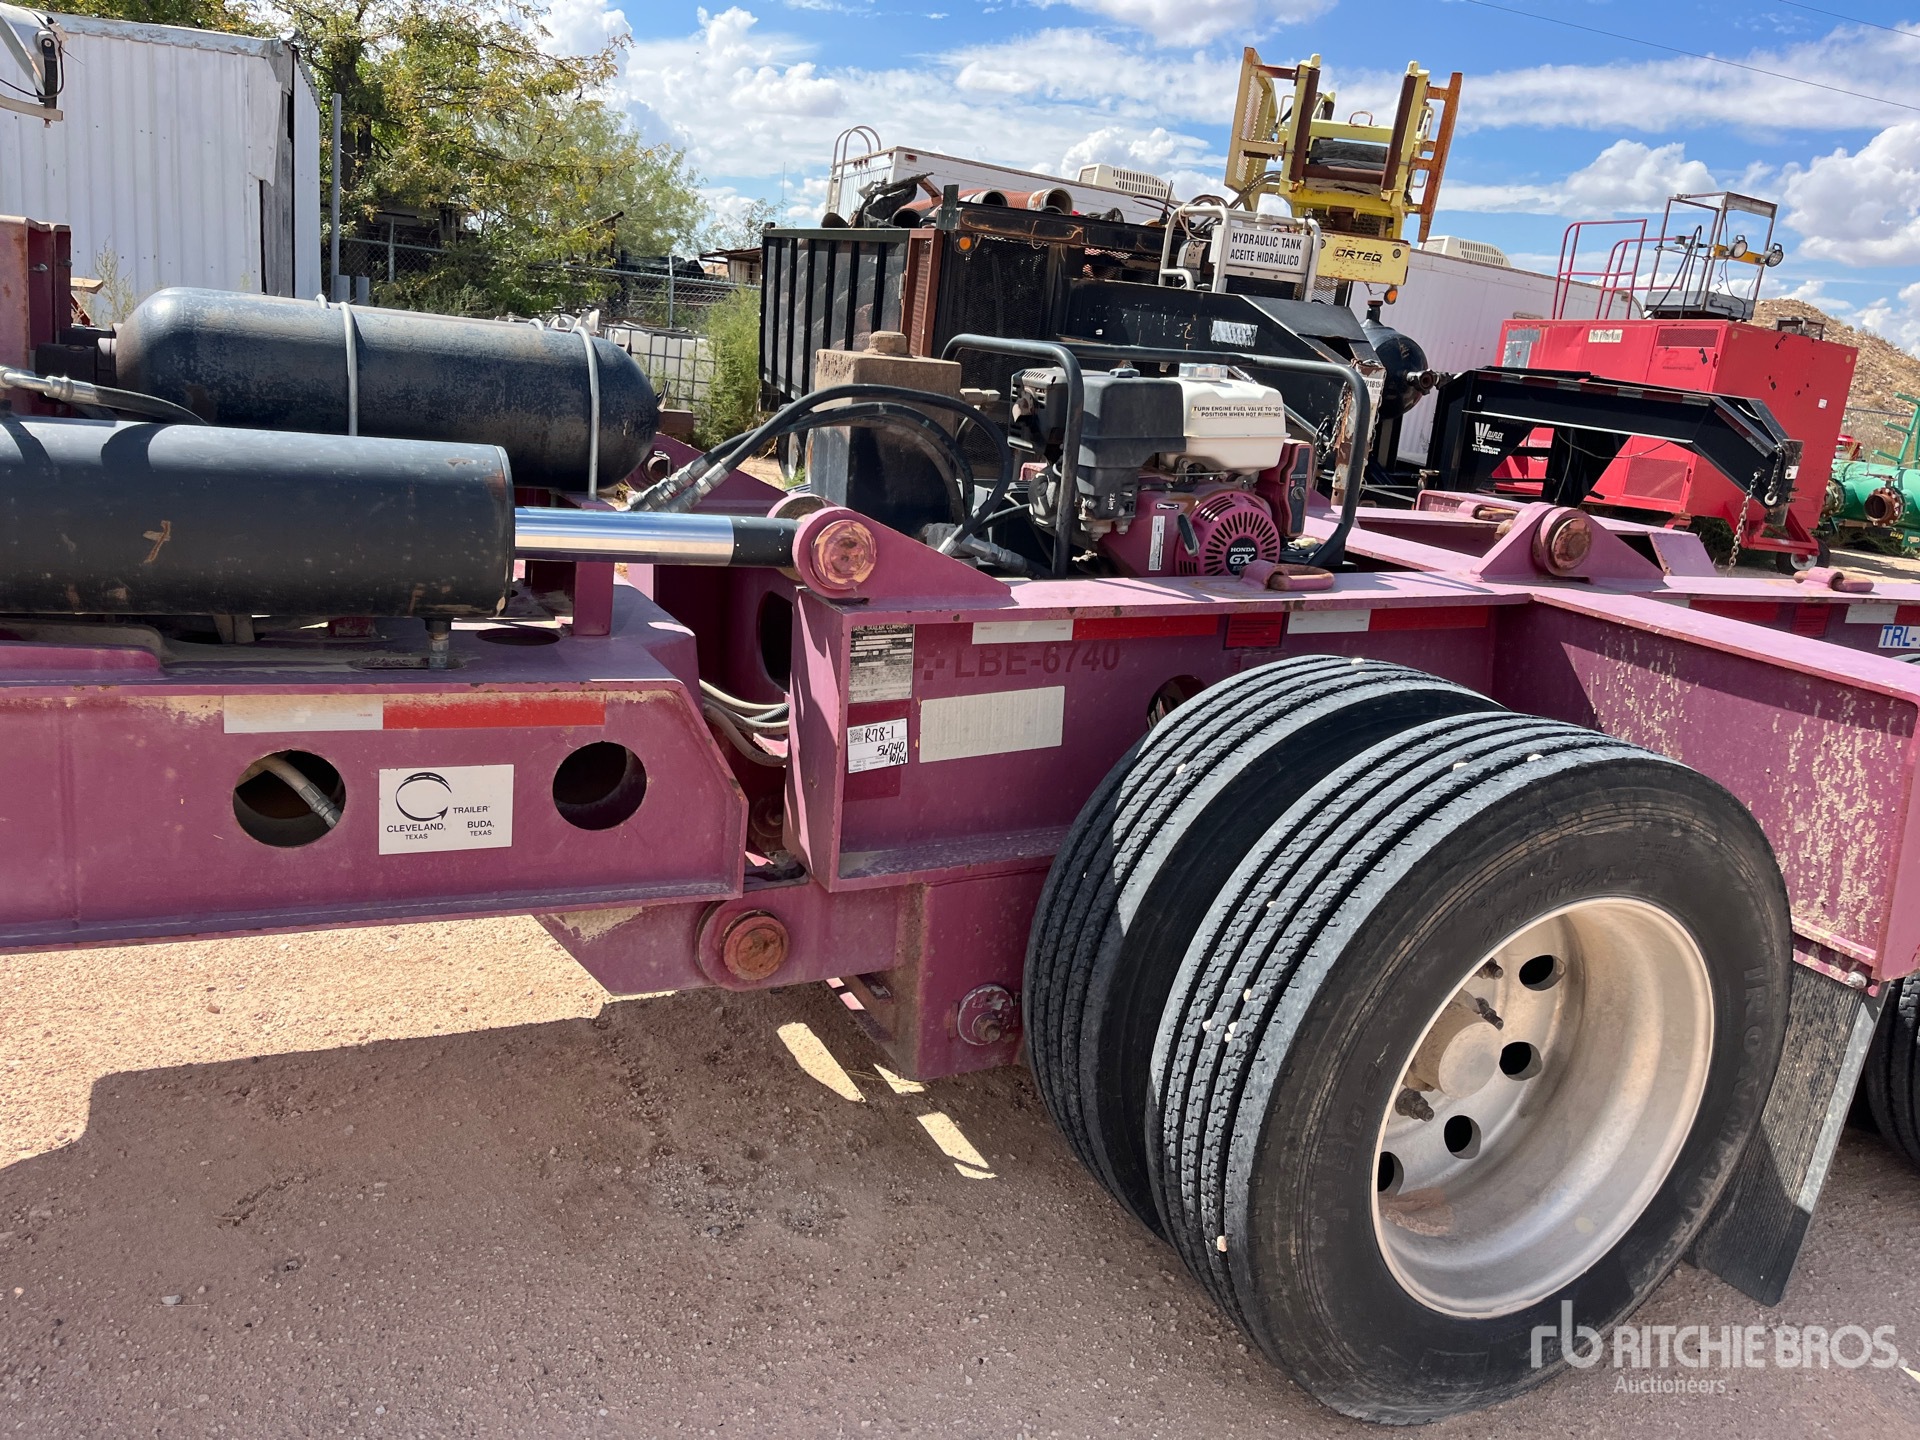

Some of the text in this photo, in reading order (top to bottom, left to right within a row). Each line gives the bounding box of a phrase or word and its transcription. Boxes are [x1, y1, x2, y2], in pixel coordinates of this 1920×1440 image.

[1232, 232, 1302, 250] HYDRAULIC TANK
[1230, 248, 1299, 266] ACEITE HIDRÁULICO
[1335, 248, 1383, 263] ORTEQ
[1229, 553, 1254, 565] GX
[955, 642, 1121, 679] LBE-6740
[452, 806, 489, 814] TRAILER
[386, 820, 495, 833] CLEVELAND, BUDA,
